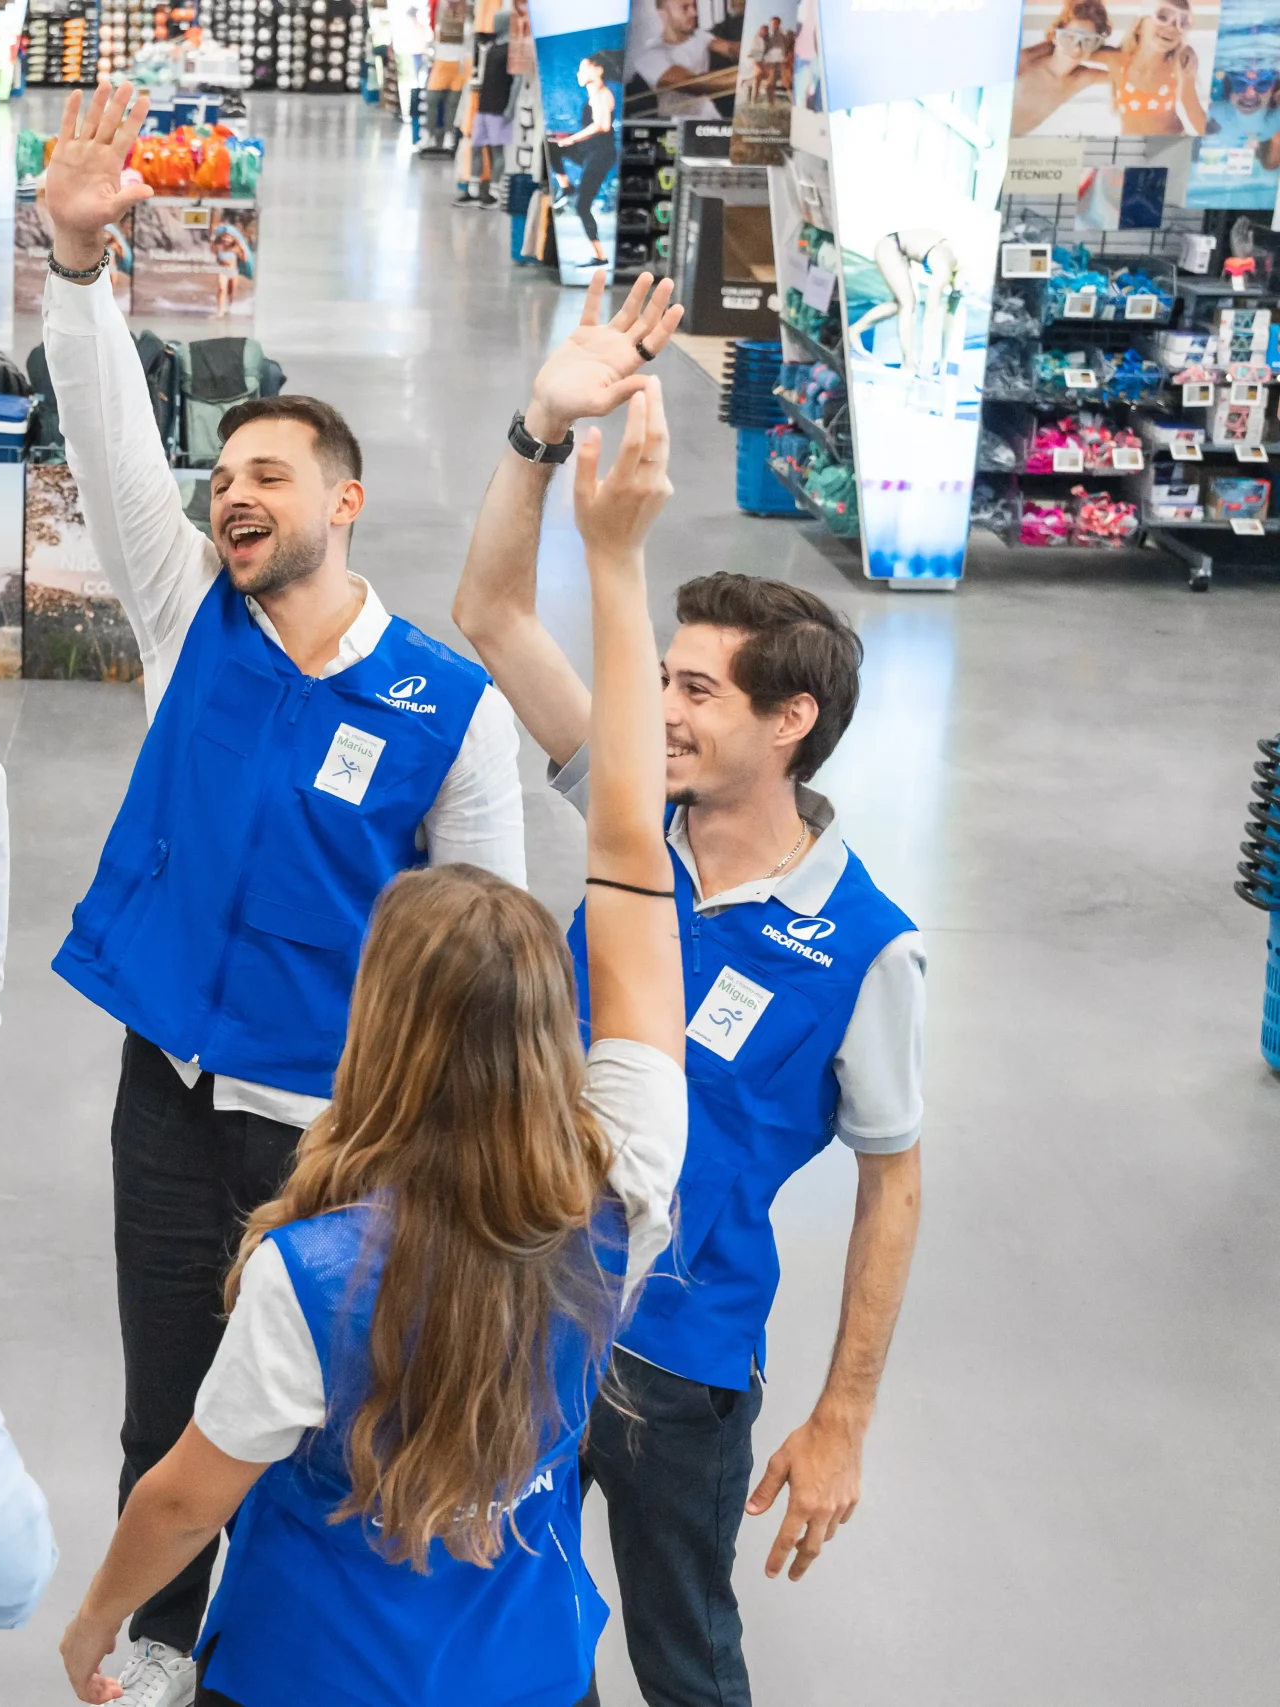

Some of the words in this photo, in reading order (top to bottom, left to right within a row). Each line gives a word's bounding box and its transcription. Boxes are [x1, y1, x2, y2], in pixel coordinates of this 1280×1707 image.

[1010, 168, 1062, 180] TÉCNICO
[337, 735, 374, 758] Marius
[761, 924, 834, 968] DECATHLON
